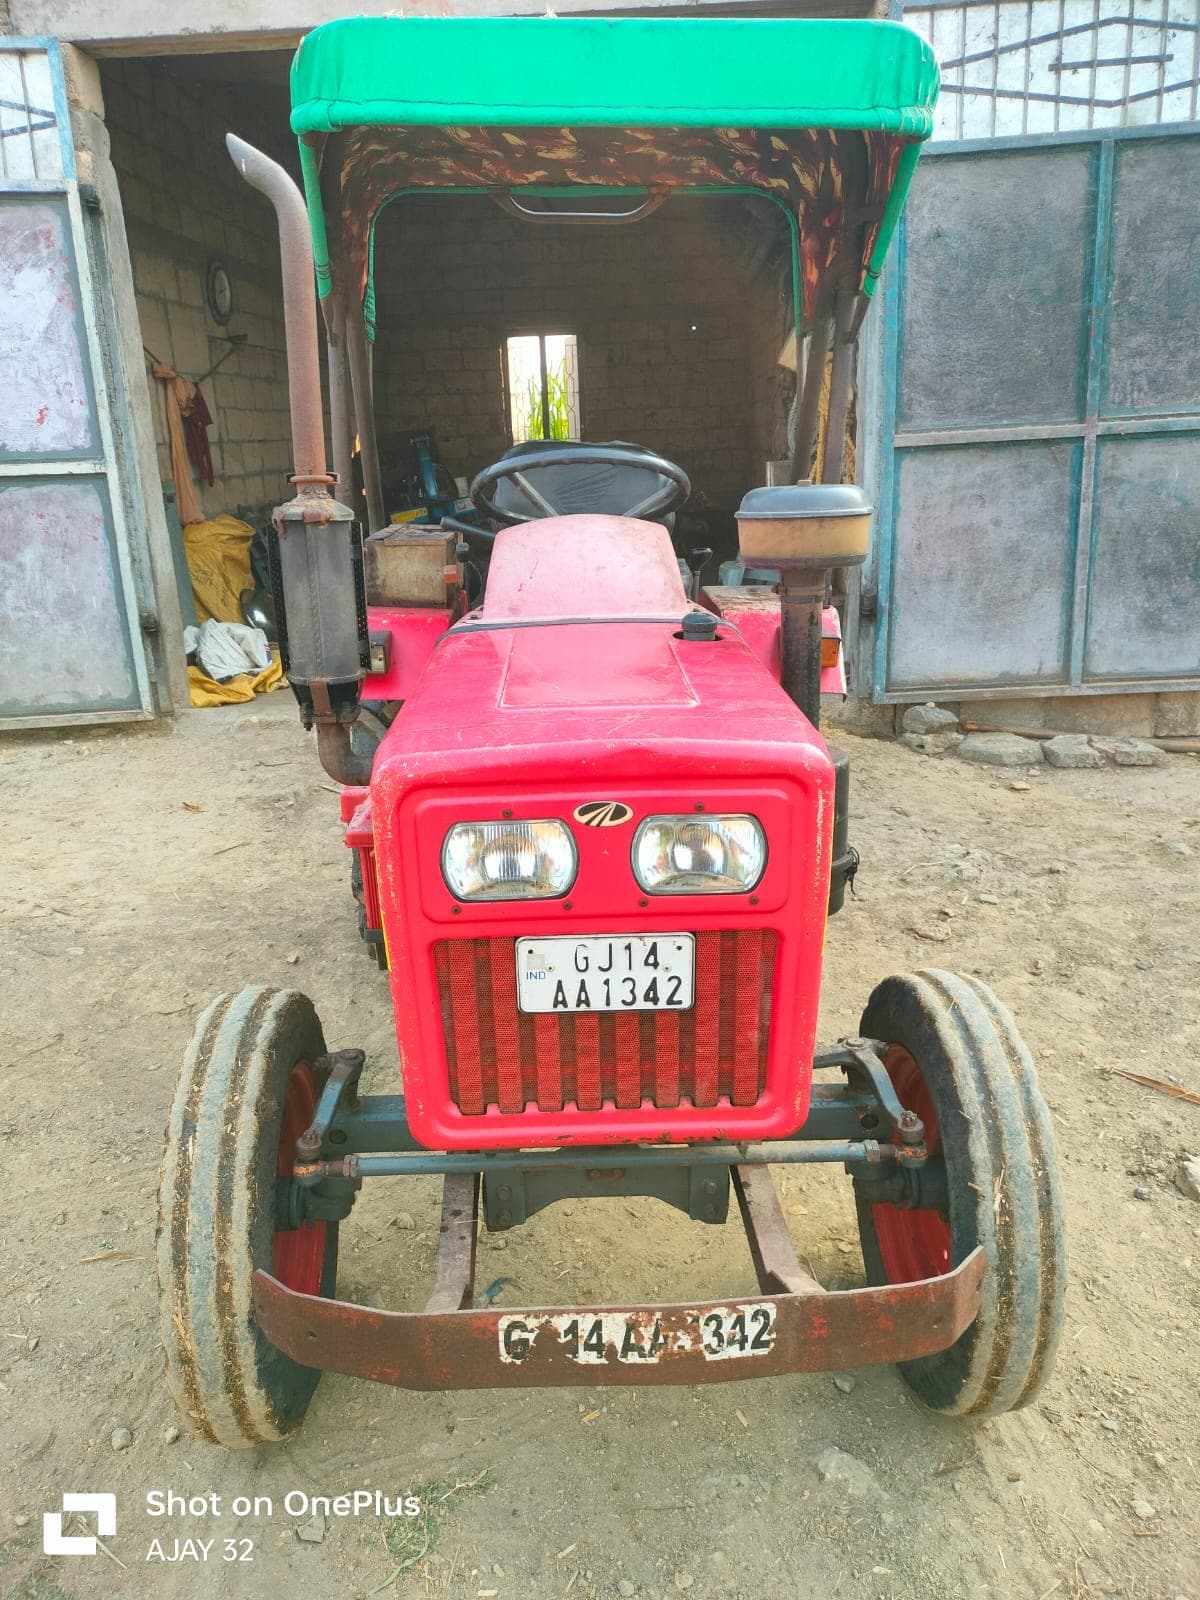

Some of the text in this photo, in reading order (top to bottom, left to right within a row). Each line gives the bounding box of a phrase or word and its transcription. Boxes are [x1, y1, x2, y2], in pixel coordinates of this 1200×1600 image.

[574, 941, 660, 973] GJ14
[526, 971, 546, 980] IND
[552, 975, 683, 1009] AA1342
[686, 1308, 772, 1355] 342
